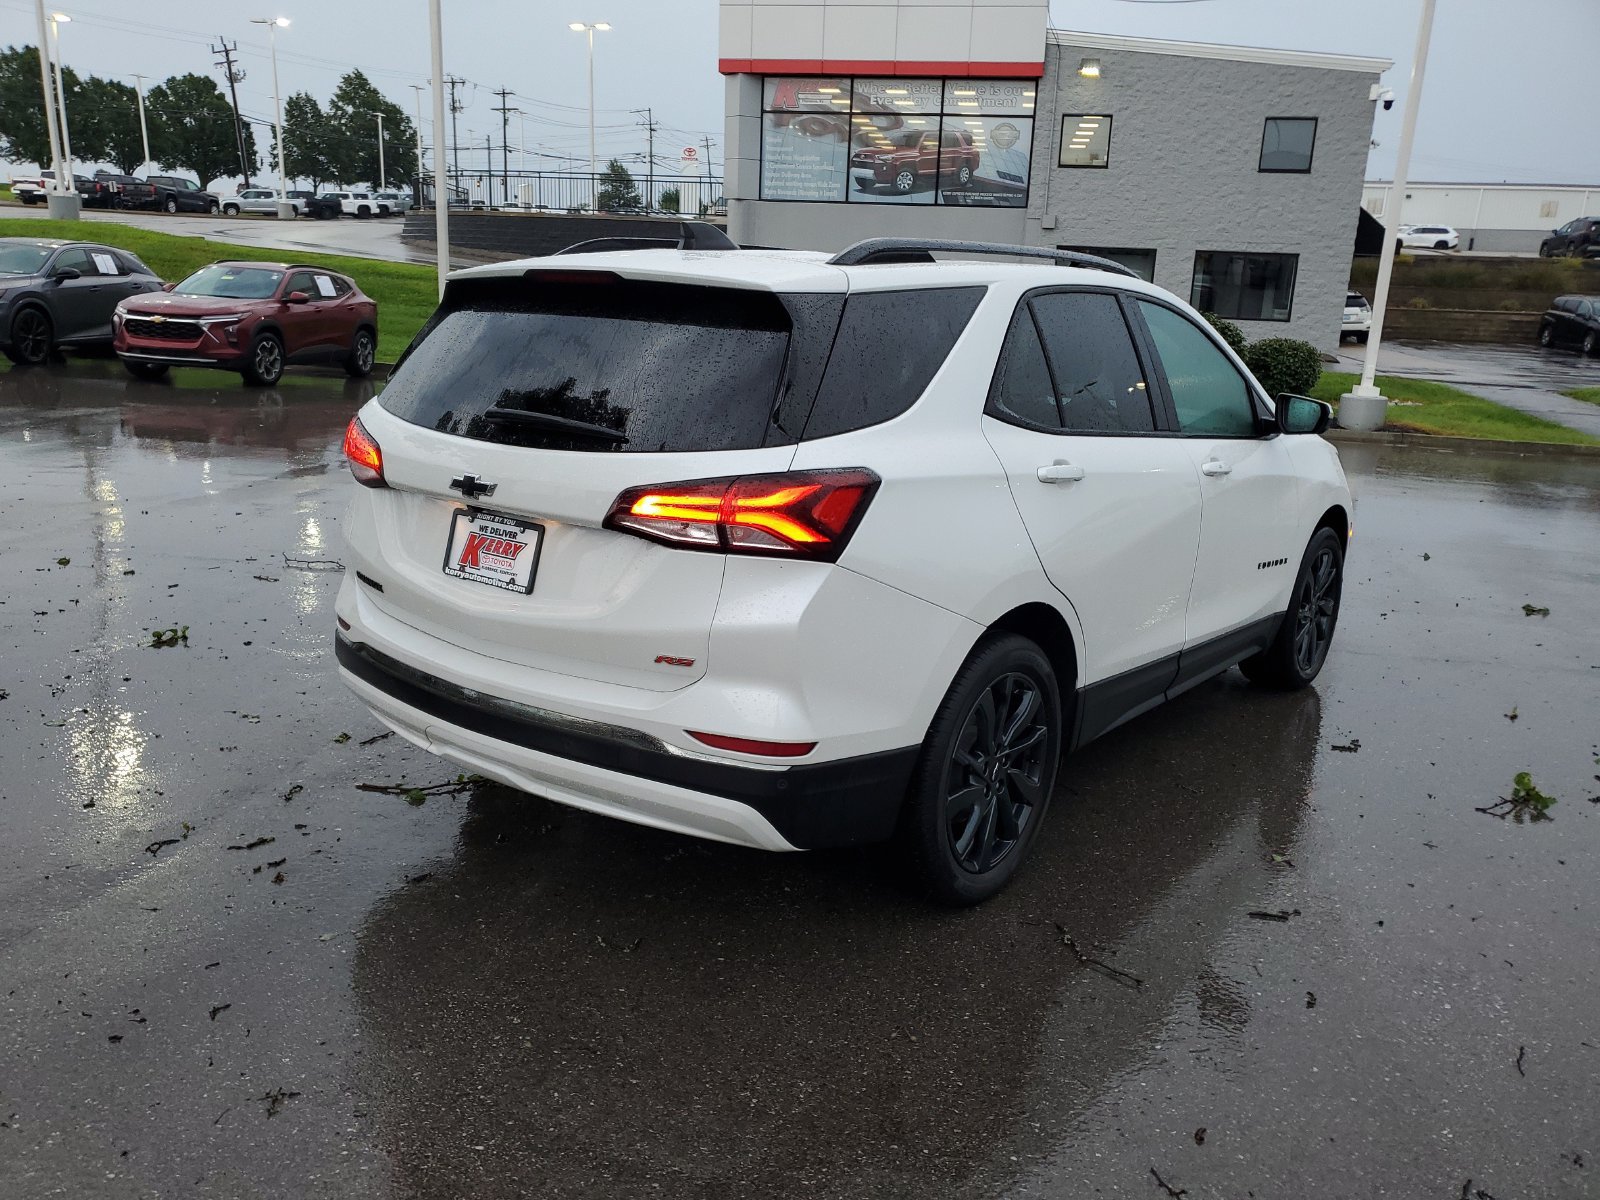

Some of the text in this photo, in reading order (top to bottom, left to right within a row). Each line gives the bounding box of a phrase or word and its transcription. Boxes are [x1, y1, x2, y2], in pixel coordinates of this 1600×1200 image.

[990, 83, 1001, 95] is
[504, 518, 517, 526] YOU
[479, 524, 518, 540] WE DELIVER
[458, 531, 528, 570] KERRY
[490, 557, 513, 568] TOYOTA
[445, 566, 526, 593] kerryautomotive.com
[654, 655, 696, 667] RS
